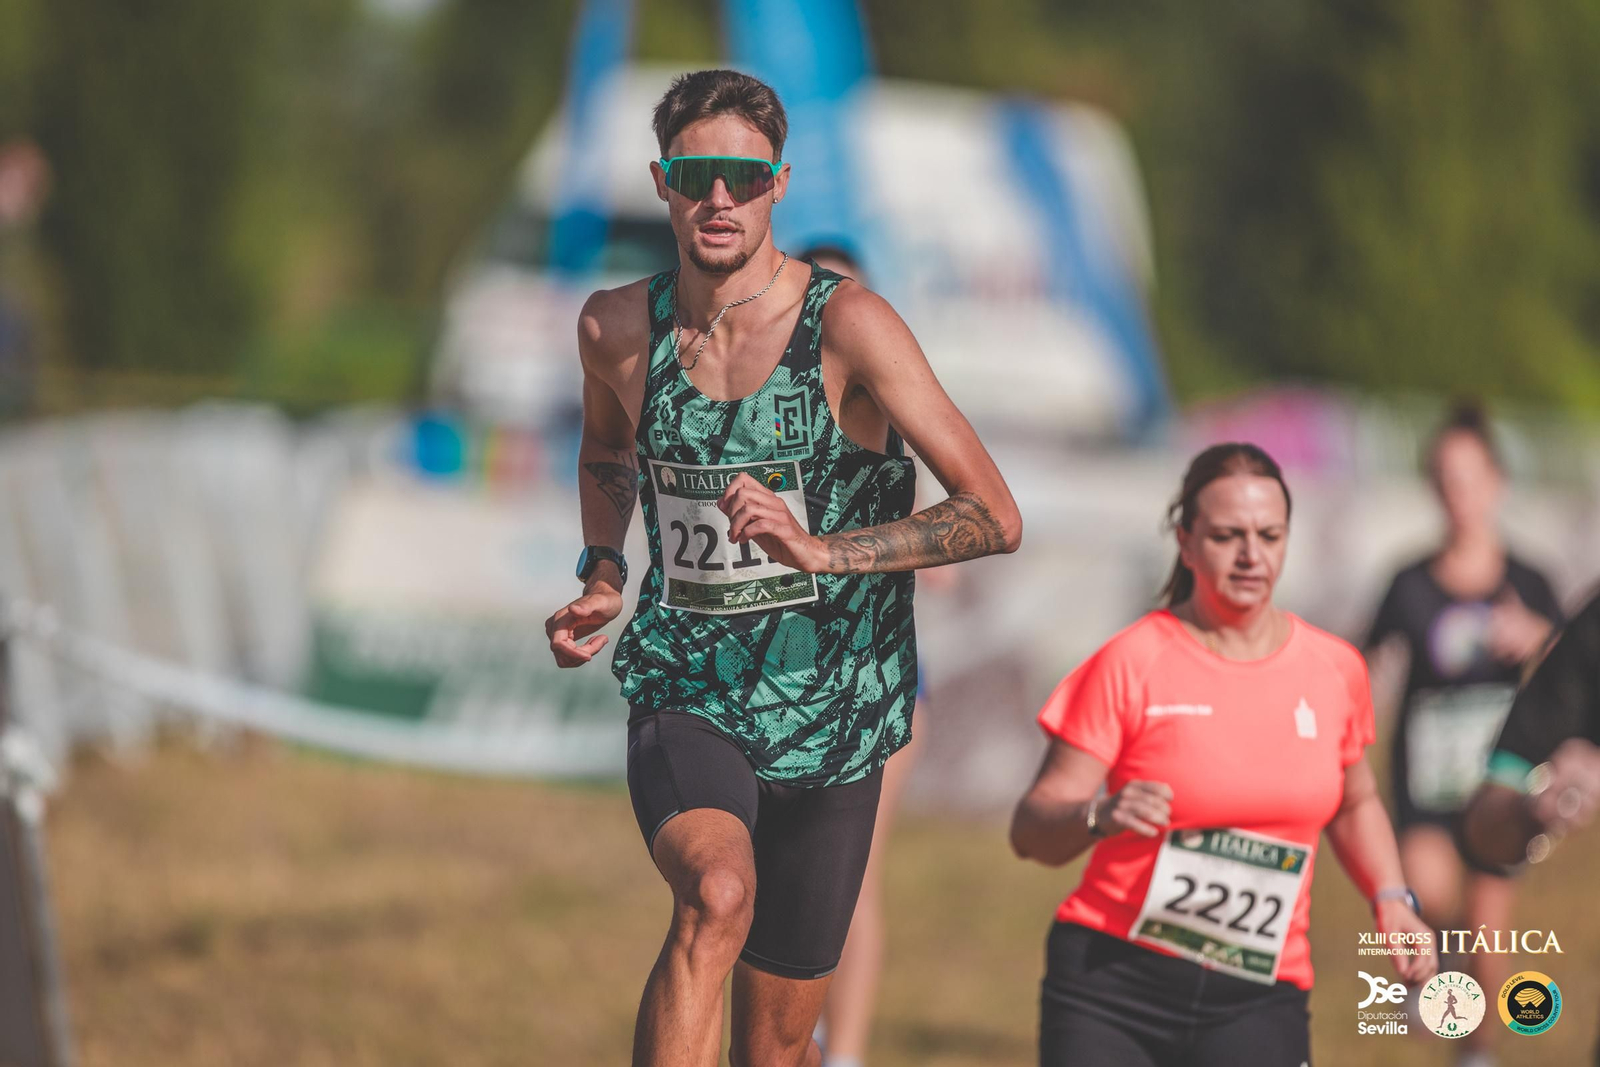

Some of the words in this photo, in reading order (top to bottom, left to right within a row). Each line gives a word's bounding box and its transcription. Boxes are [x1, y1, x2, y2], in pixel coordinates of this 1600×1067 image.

[682, 470, 739, 490] ITÁLIC
[697, 501, 718, 509] CHOQ
[670, 520, 778, 572] 221
[1164, 875, 1284, 939] 2222
